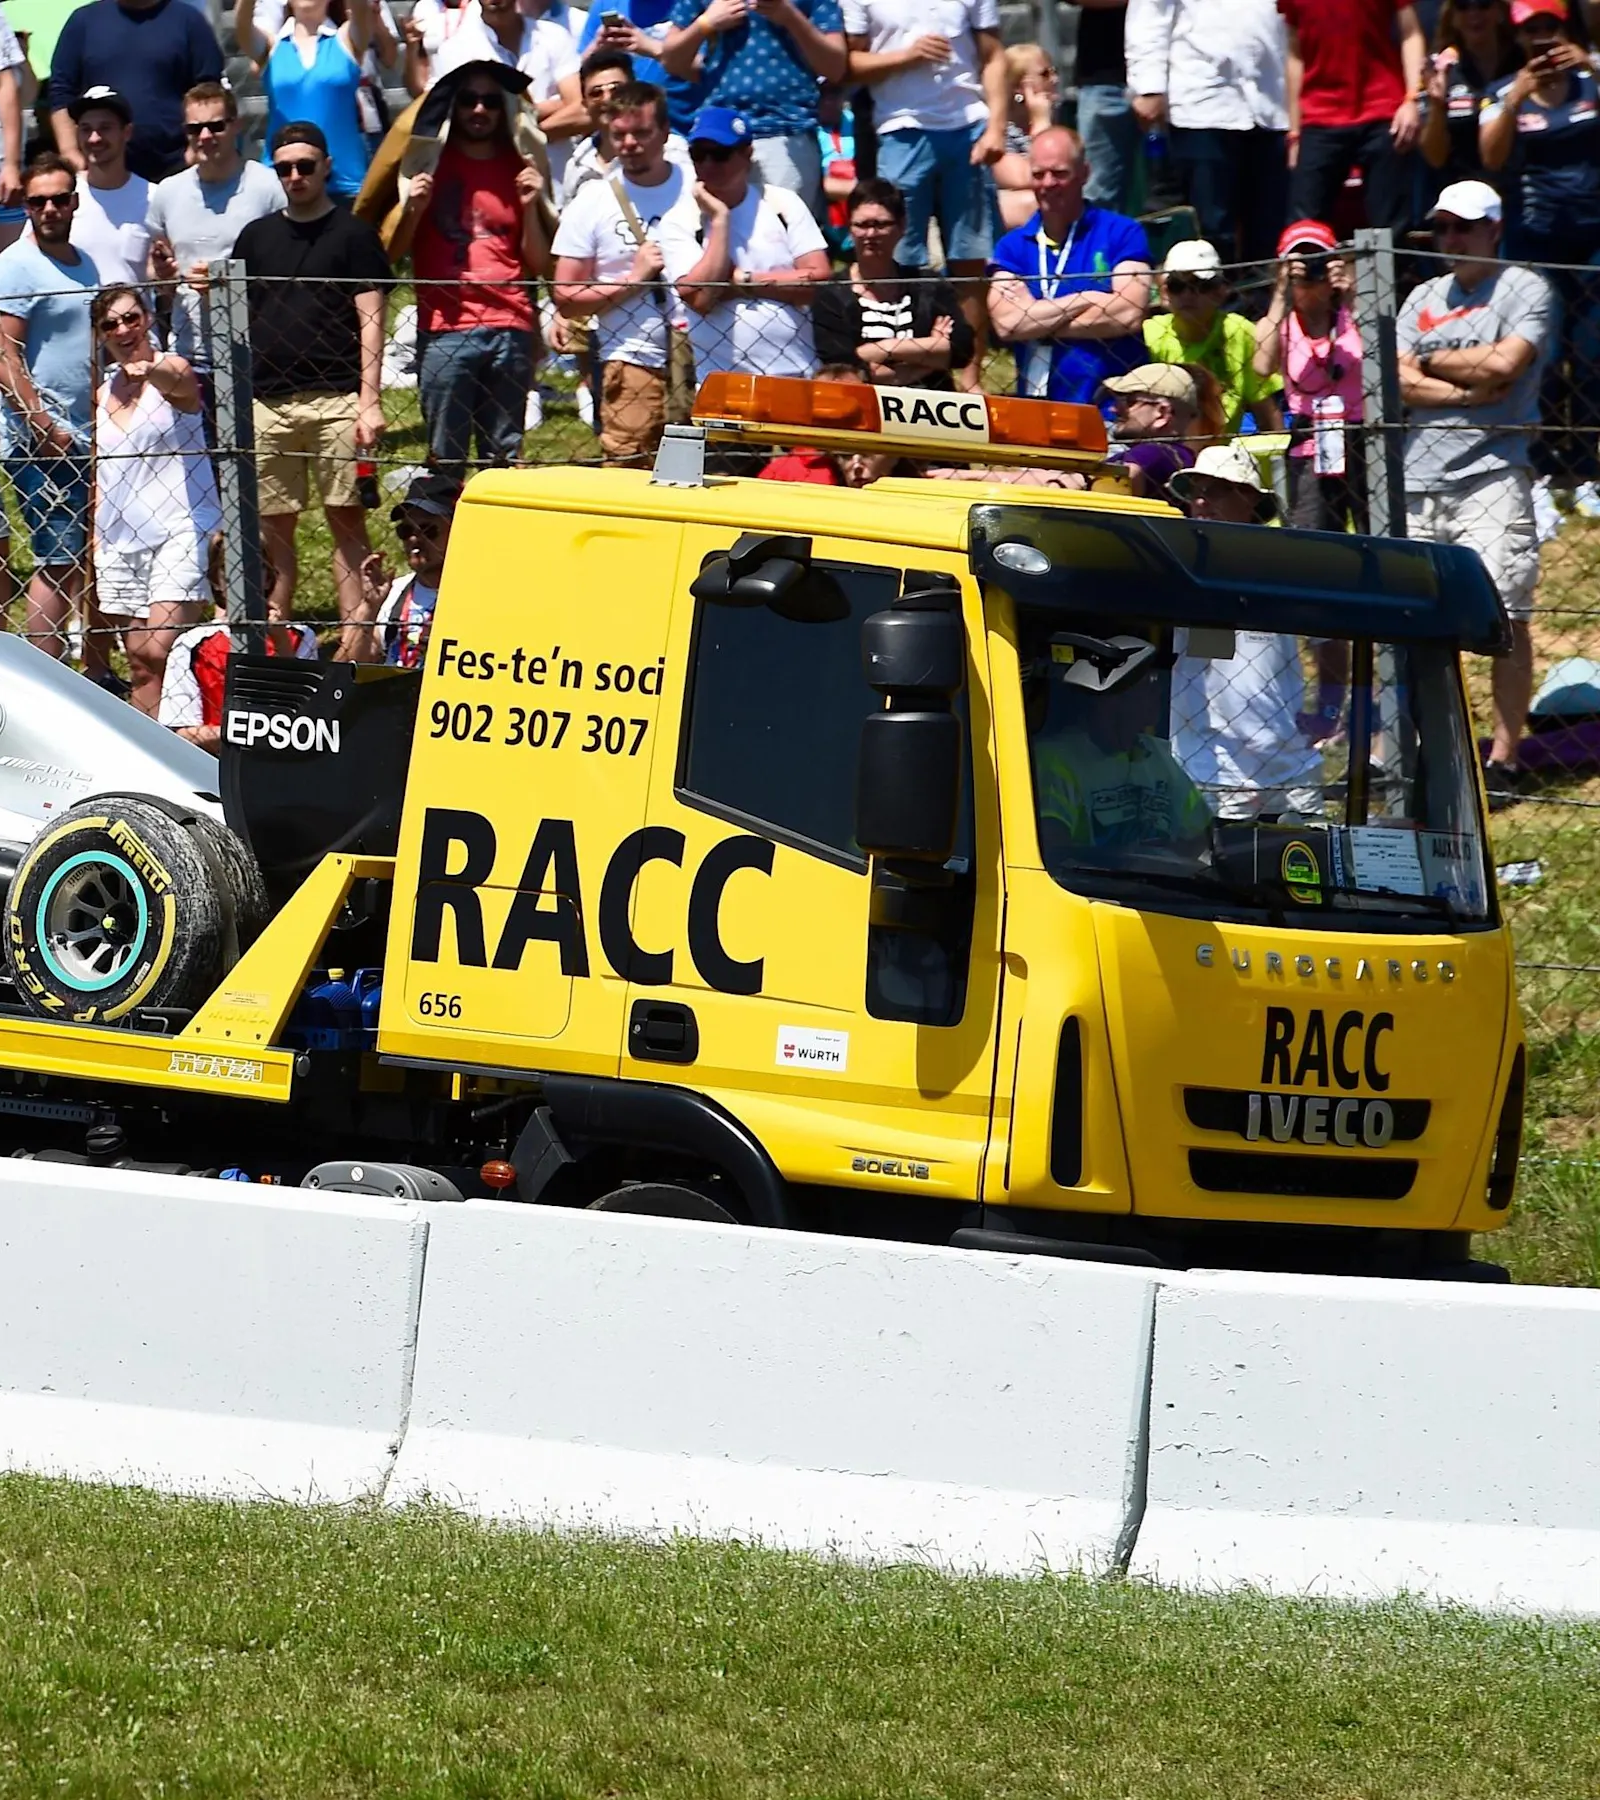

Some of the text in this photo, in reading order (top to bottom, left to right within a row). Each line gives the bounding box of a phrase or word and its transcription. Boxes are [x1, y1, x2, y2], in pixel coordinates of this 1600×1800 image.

[881, 396, 984, 430] RACC
[437, 639, 665, 696] Fes-te'n soci
[226, 710, 340, 753] EPSON
[430, 701, 648, 756] 902 307 307
[108, 819, 173, 894] PIRELLI
[410, 807, 777, 996] RACC
[10, 915, 65, 1013] ZERO
[1196, 943, 1456, 983] EUROCARGO
[418, 992, 462, 1018] 656
[798, 1048, 840, 1062] WÜRTH
[1261, 1006, 1394, 1092] RACC
[1247, 1094, 1394, 1148] IVECO
